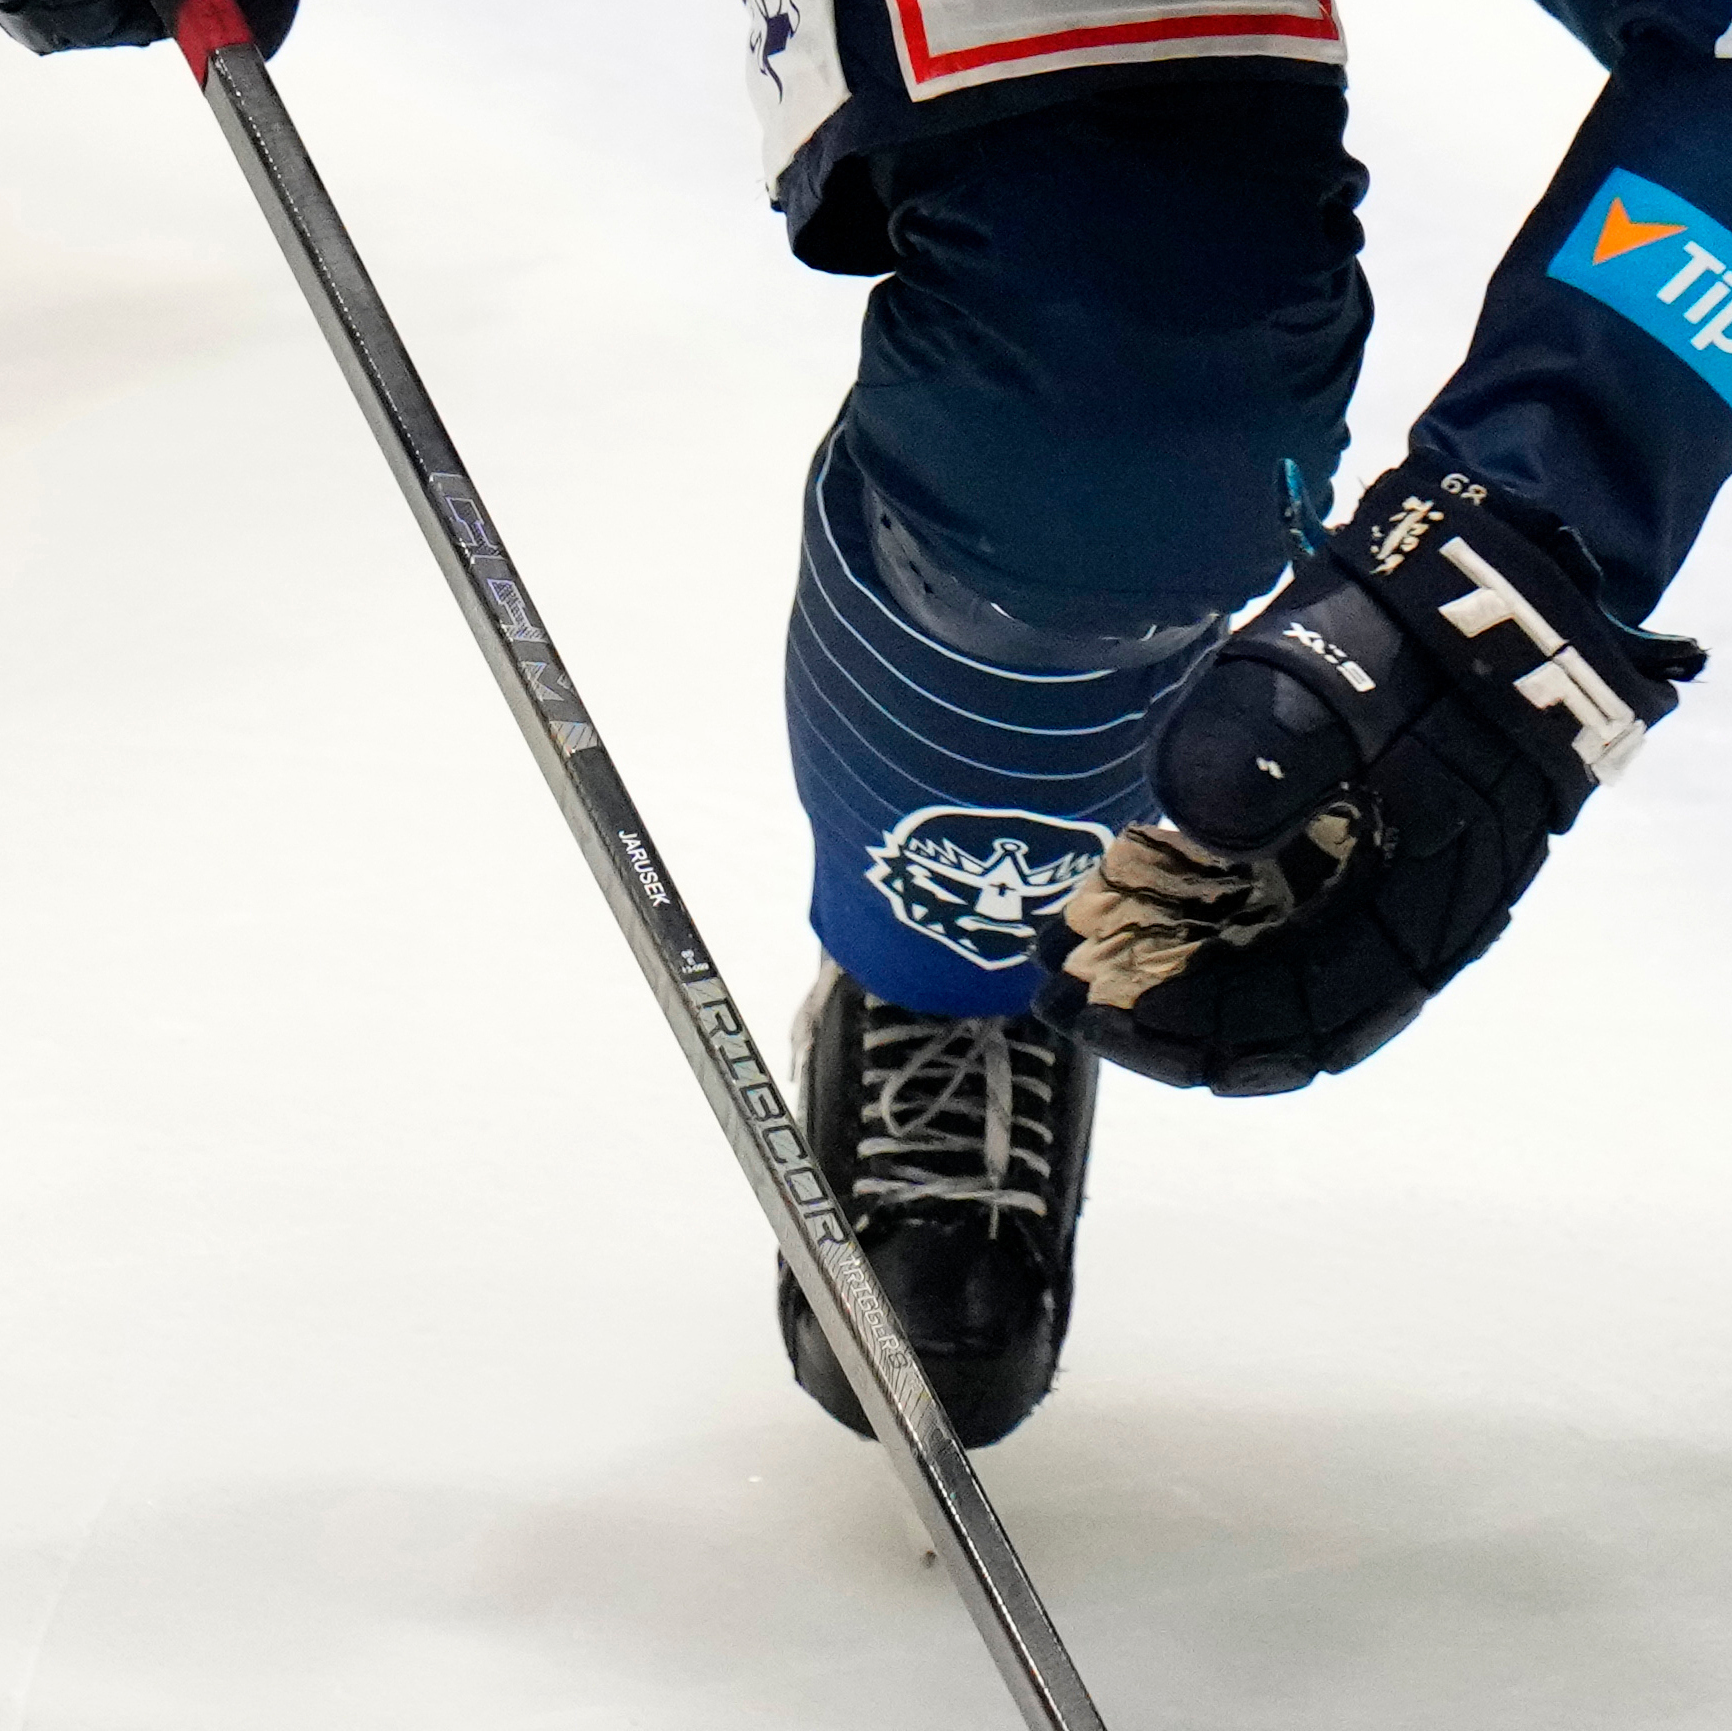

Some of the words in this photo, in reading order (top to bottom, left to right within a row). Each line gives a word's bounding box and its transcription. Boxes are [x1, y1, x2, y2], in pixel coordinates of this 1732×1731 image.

[1441, 472, 1487, 506] 68
[618, 830, 671, 907] JARUSEK
[694, 997, 850, 1245] RIBCOR
